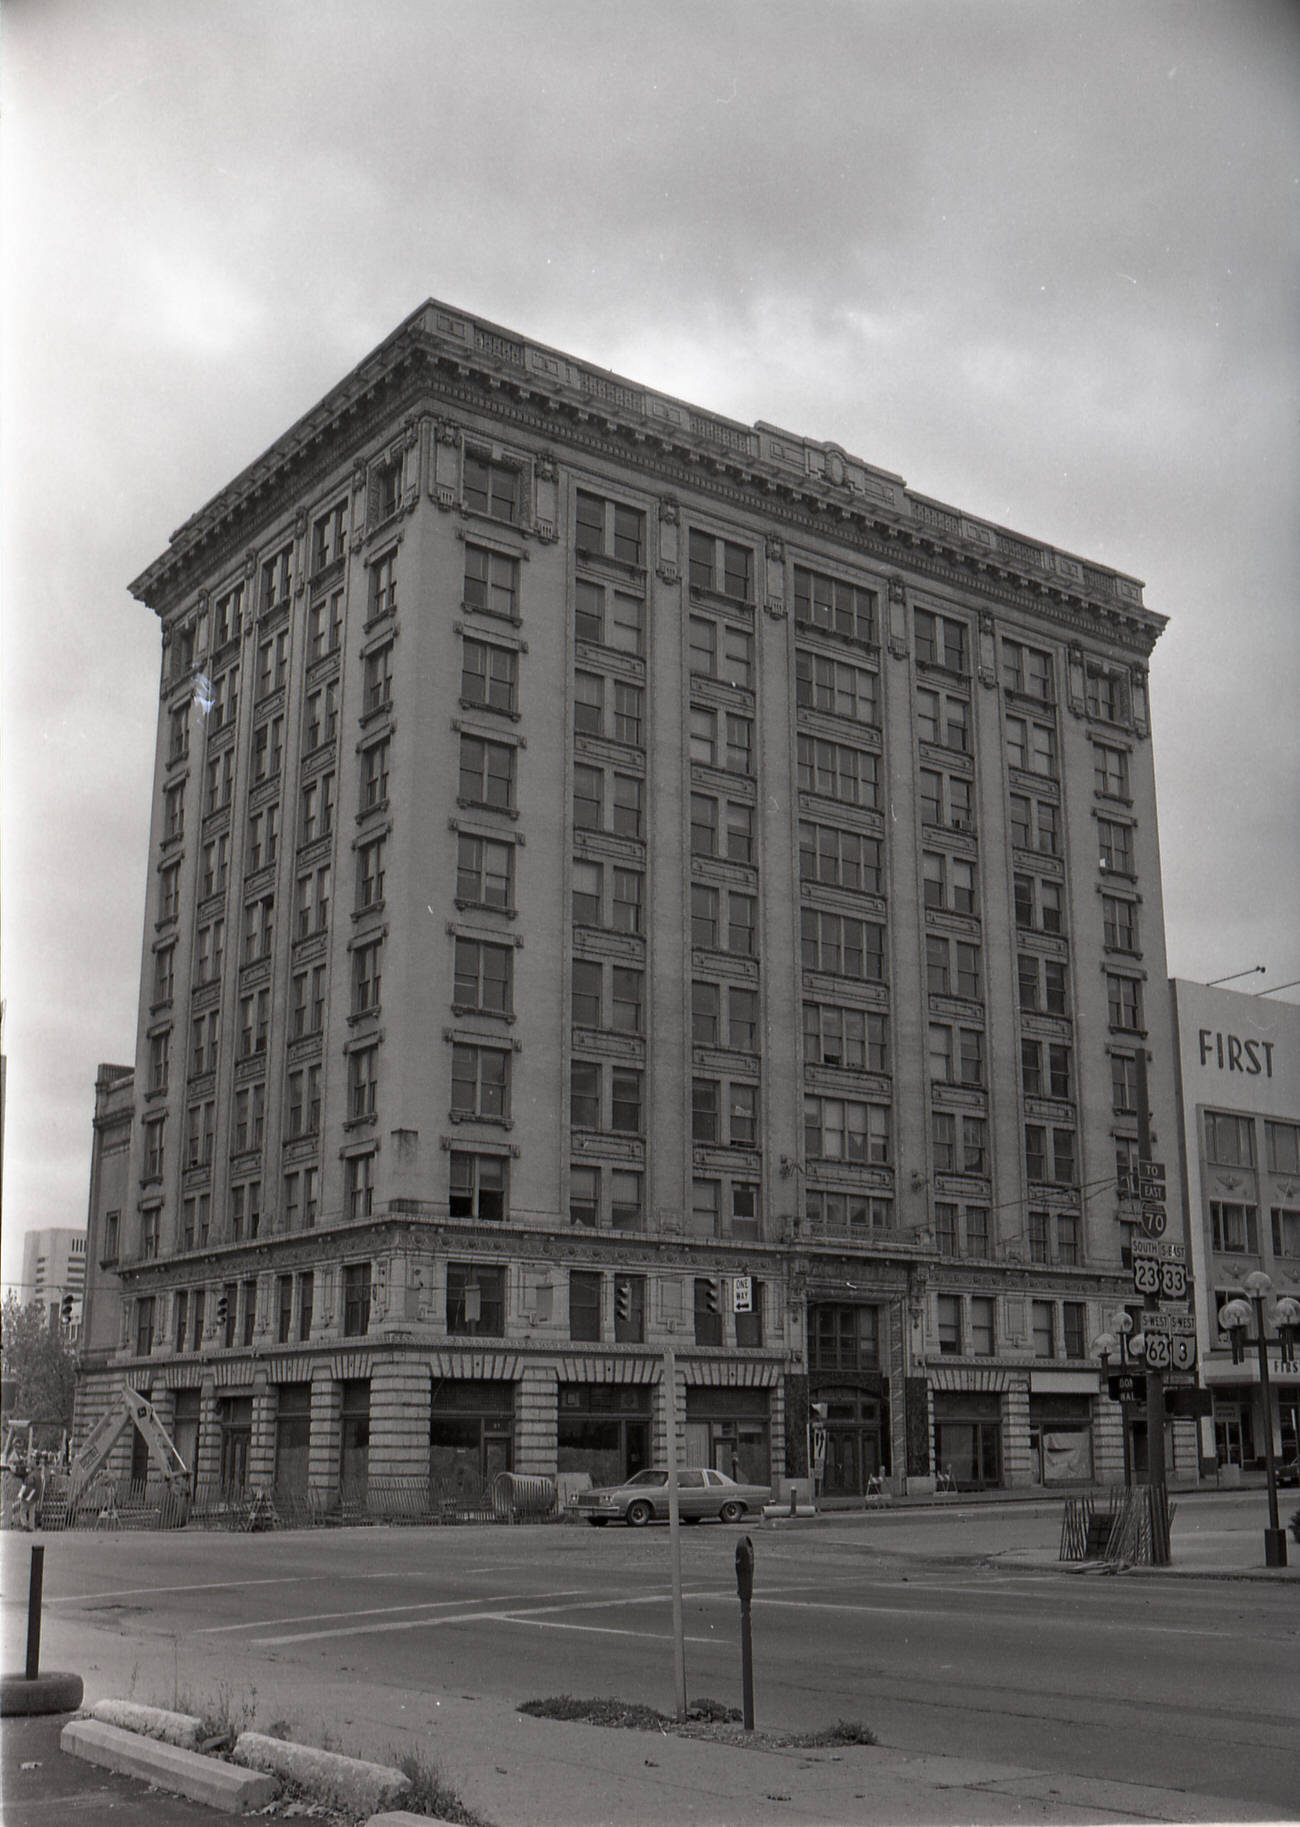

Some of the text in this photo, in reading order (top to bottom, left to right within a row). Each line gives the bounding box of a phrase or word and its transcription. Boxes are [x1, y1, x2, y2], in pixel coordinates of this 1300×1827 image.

[1198, 1029, 1274, 1077] FIRST
[1145, 1165, 1159, 1176] TO
[1144, 1185, 1161, 1197] EAST
[1145, 1214, 1164, 1231] 70
[1133, 1240, 1157, 1253] SOUTH
[736, 1278, 748, 1289] ONE
[1138, 1266, 1156, 1287] 23
[1166, 1270, 1182, 1291] 33
[736, 1292, 748, 1301] WAY
[1149, 1341, 1166, 1361] 62
[1179, 1342, 1187, 1362] 3
